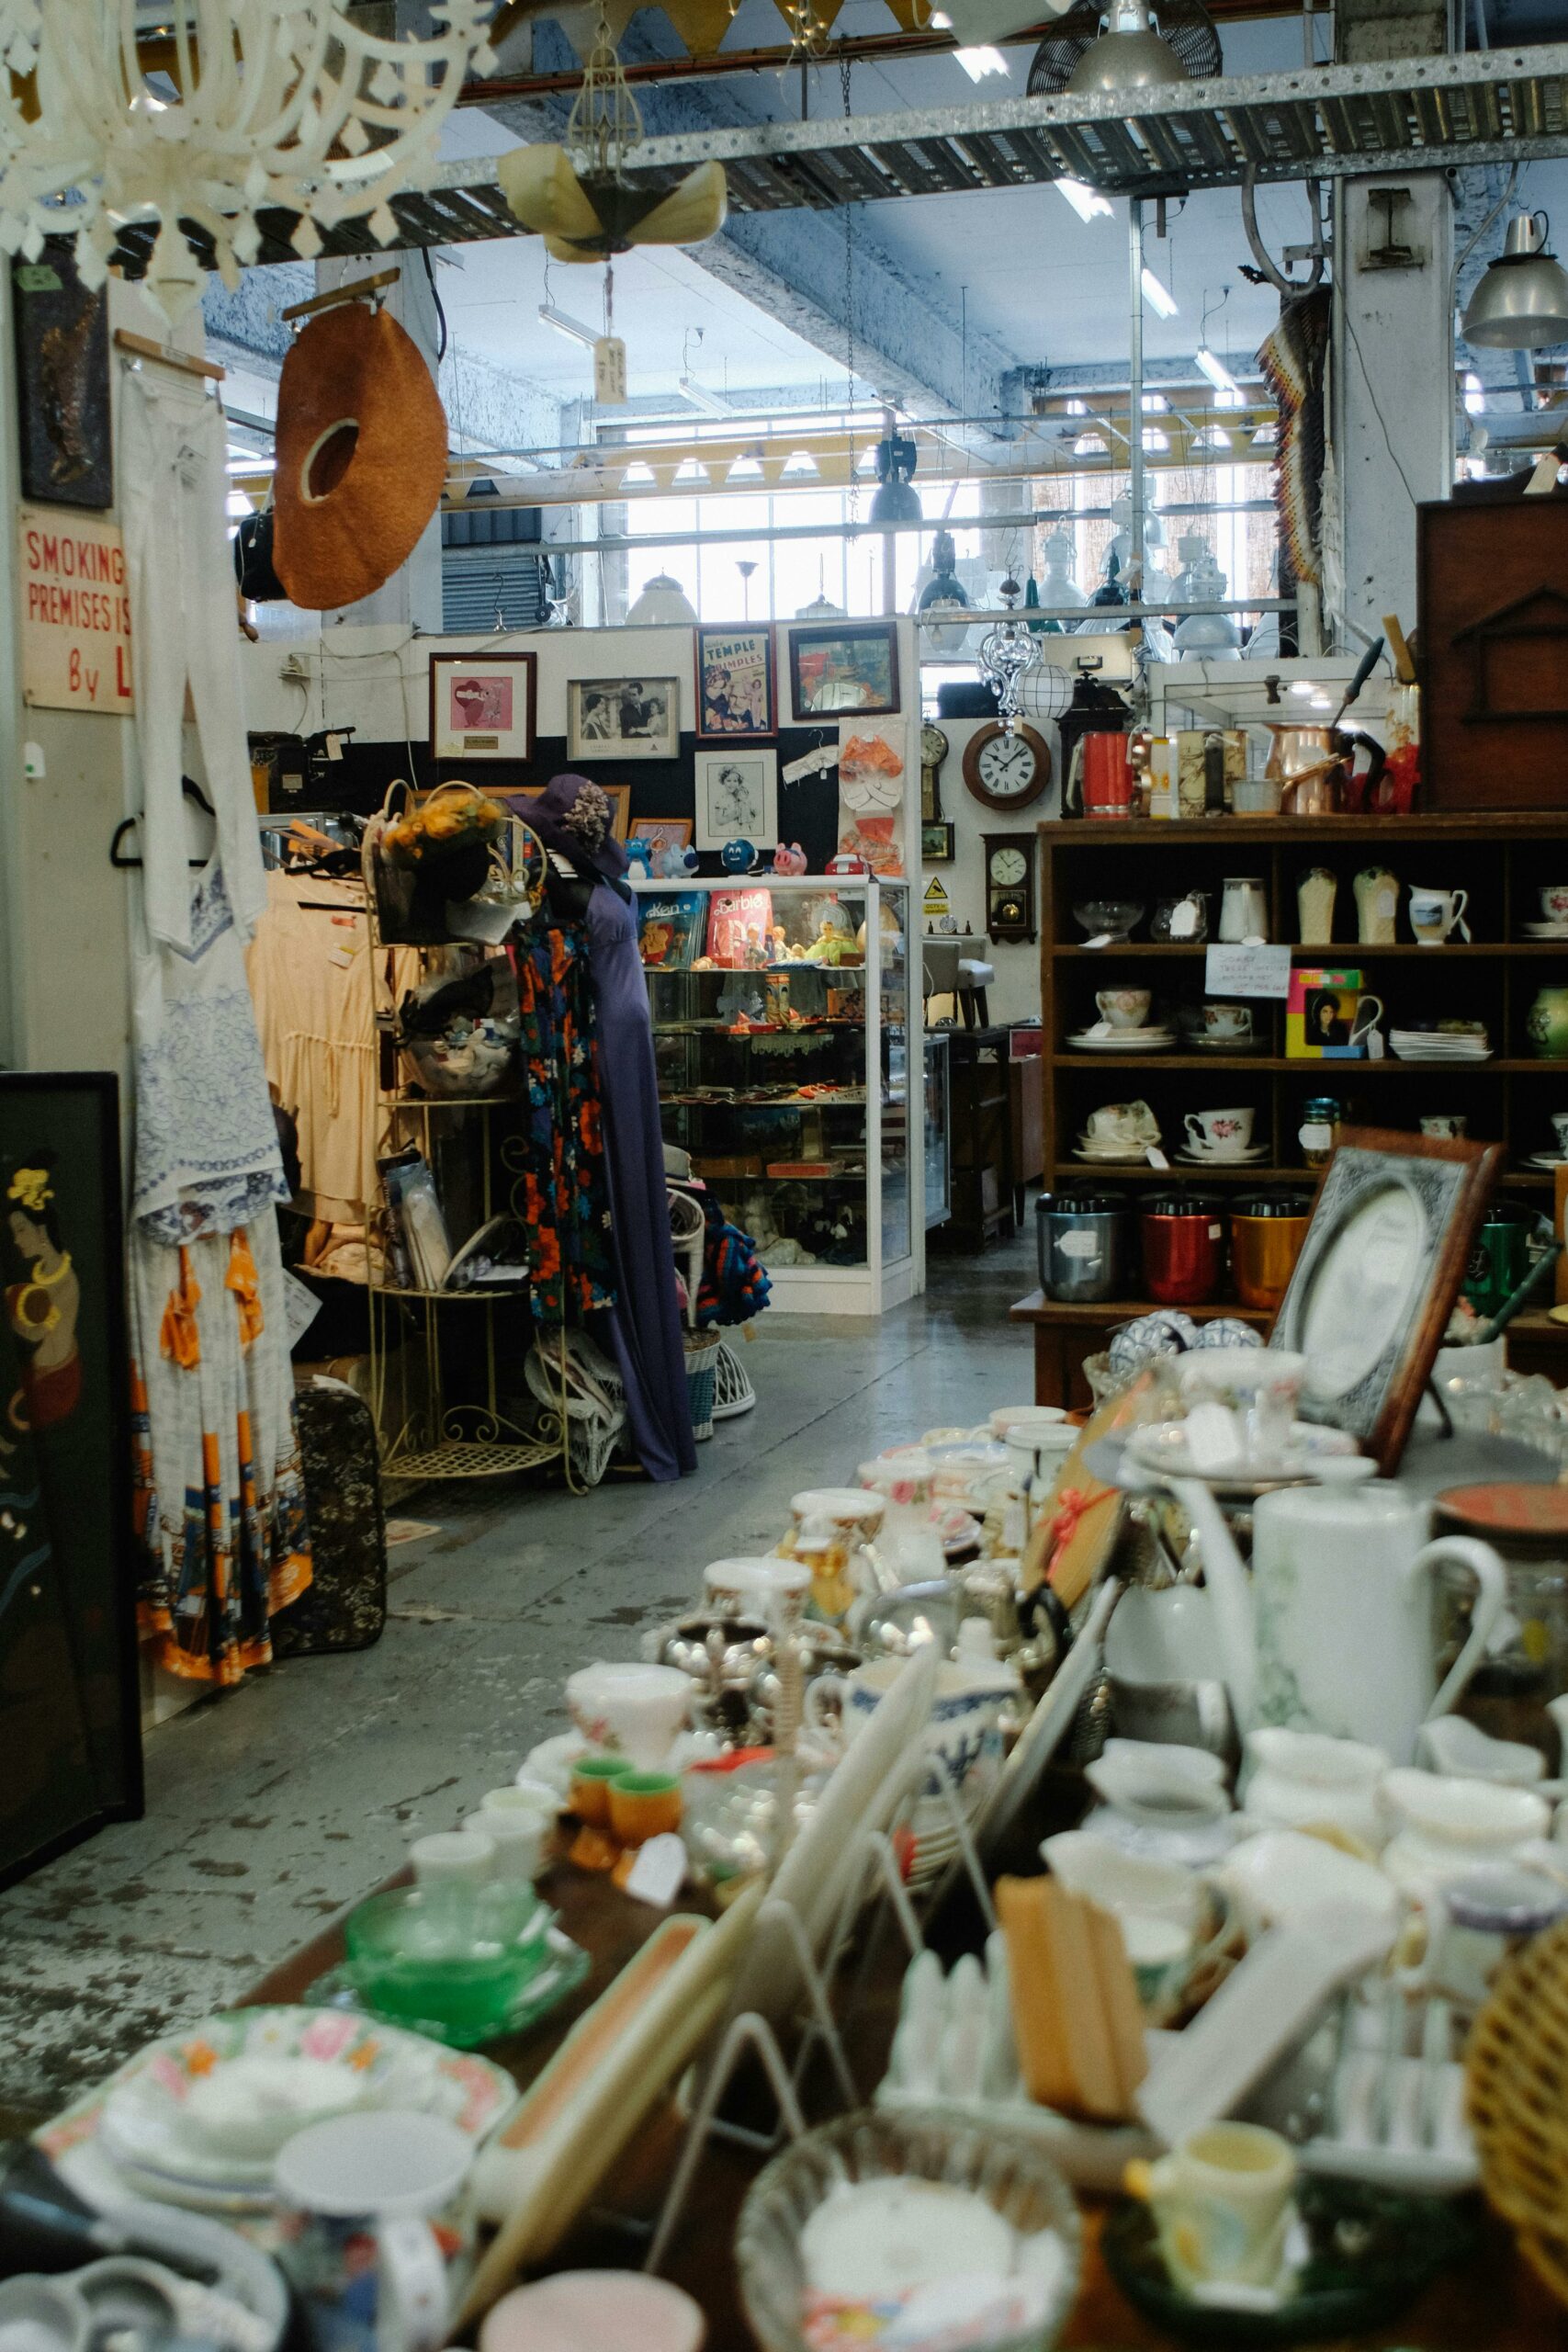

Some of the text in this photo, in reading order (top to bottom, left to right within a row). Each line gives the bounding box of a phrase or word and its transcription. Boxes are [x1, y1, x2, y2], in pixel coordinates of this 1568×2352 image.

[27, 530, 125, 585] SMOKING
[28, 582, 130, 636] PREMISES IS
[706, 639, 755, 661] TEMPLE
[646, 902, 681, 918] Ken
[714, 893, 763, 916] Barbie
